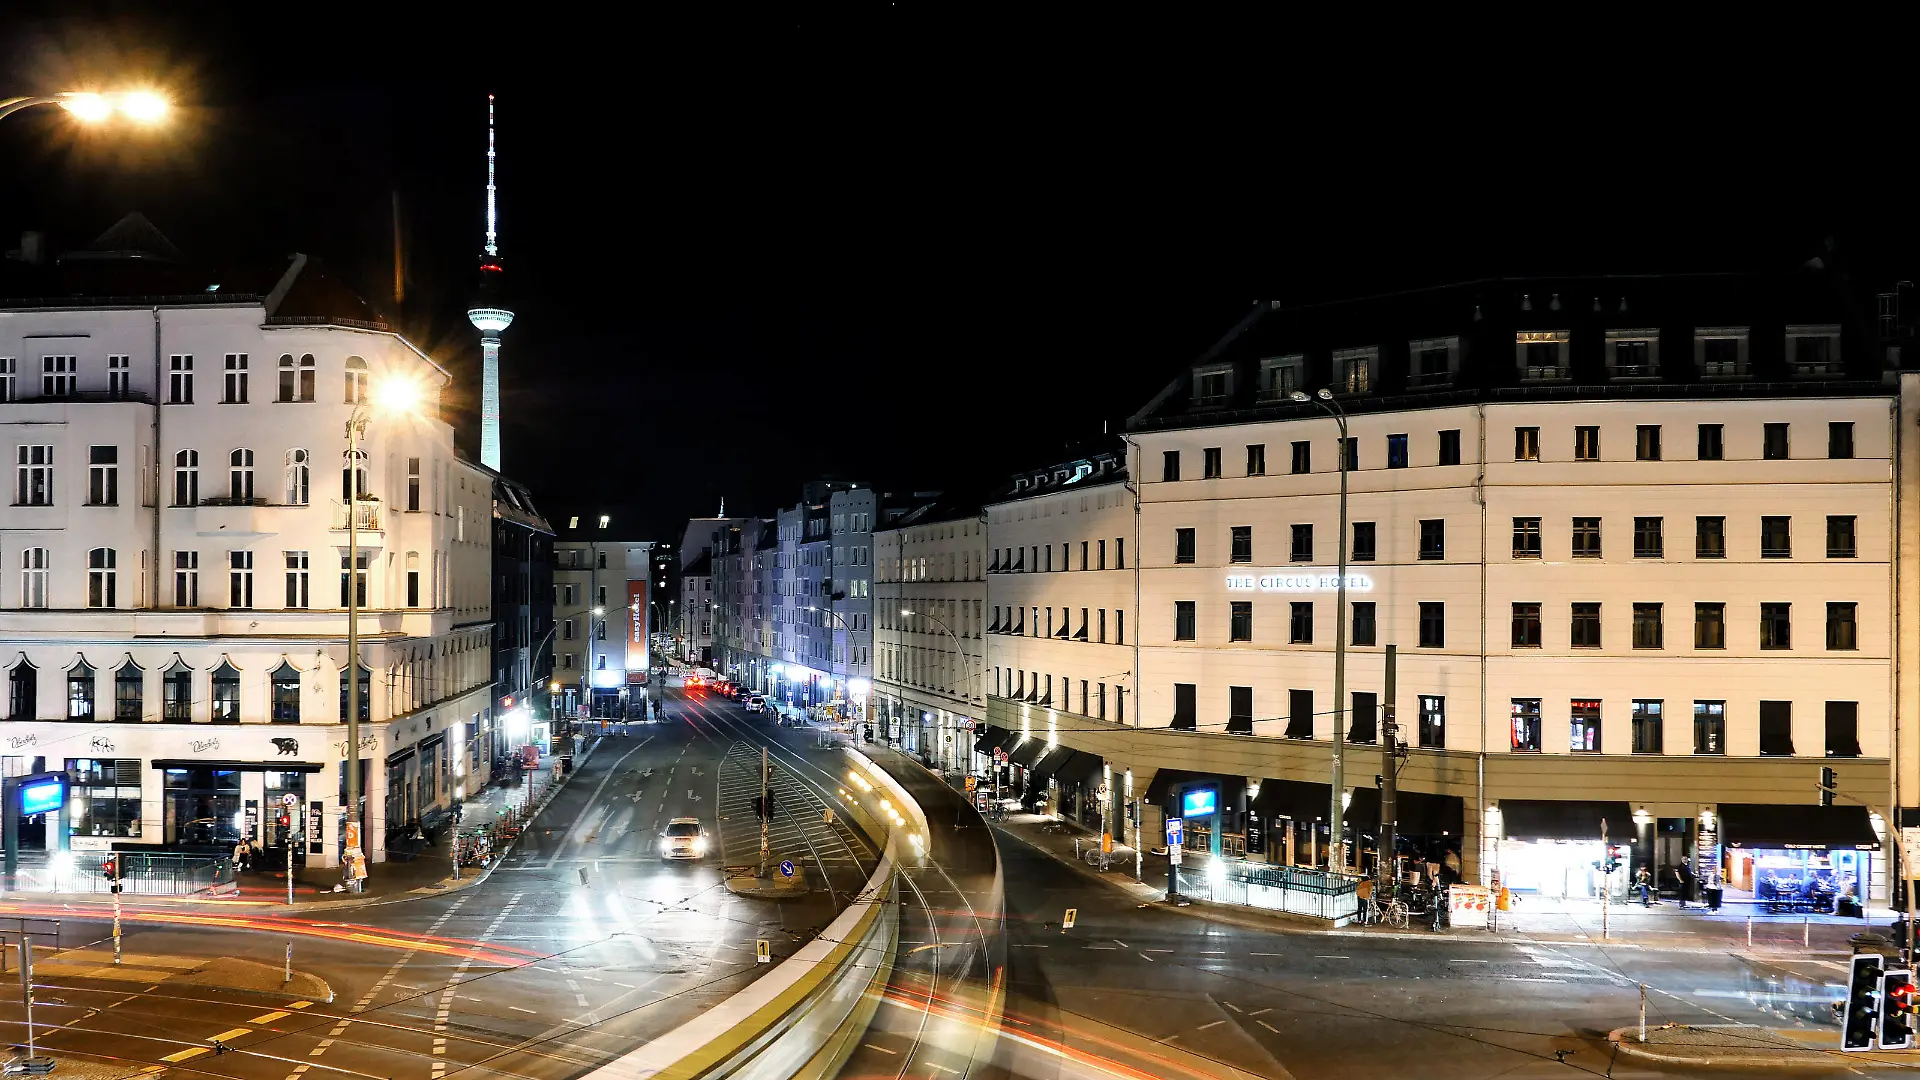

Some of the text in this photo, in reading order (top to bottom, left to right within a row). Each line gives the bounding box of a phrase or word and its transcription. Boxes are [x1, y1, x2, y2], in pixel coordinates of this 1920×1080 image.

[1226, 577, 1368, 588] THE CIRCUS HOEL
